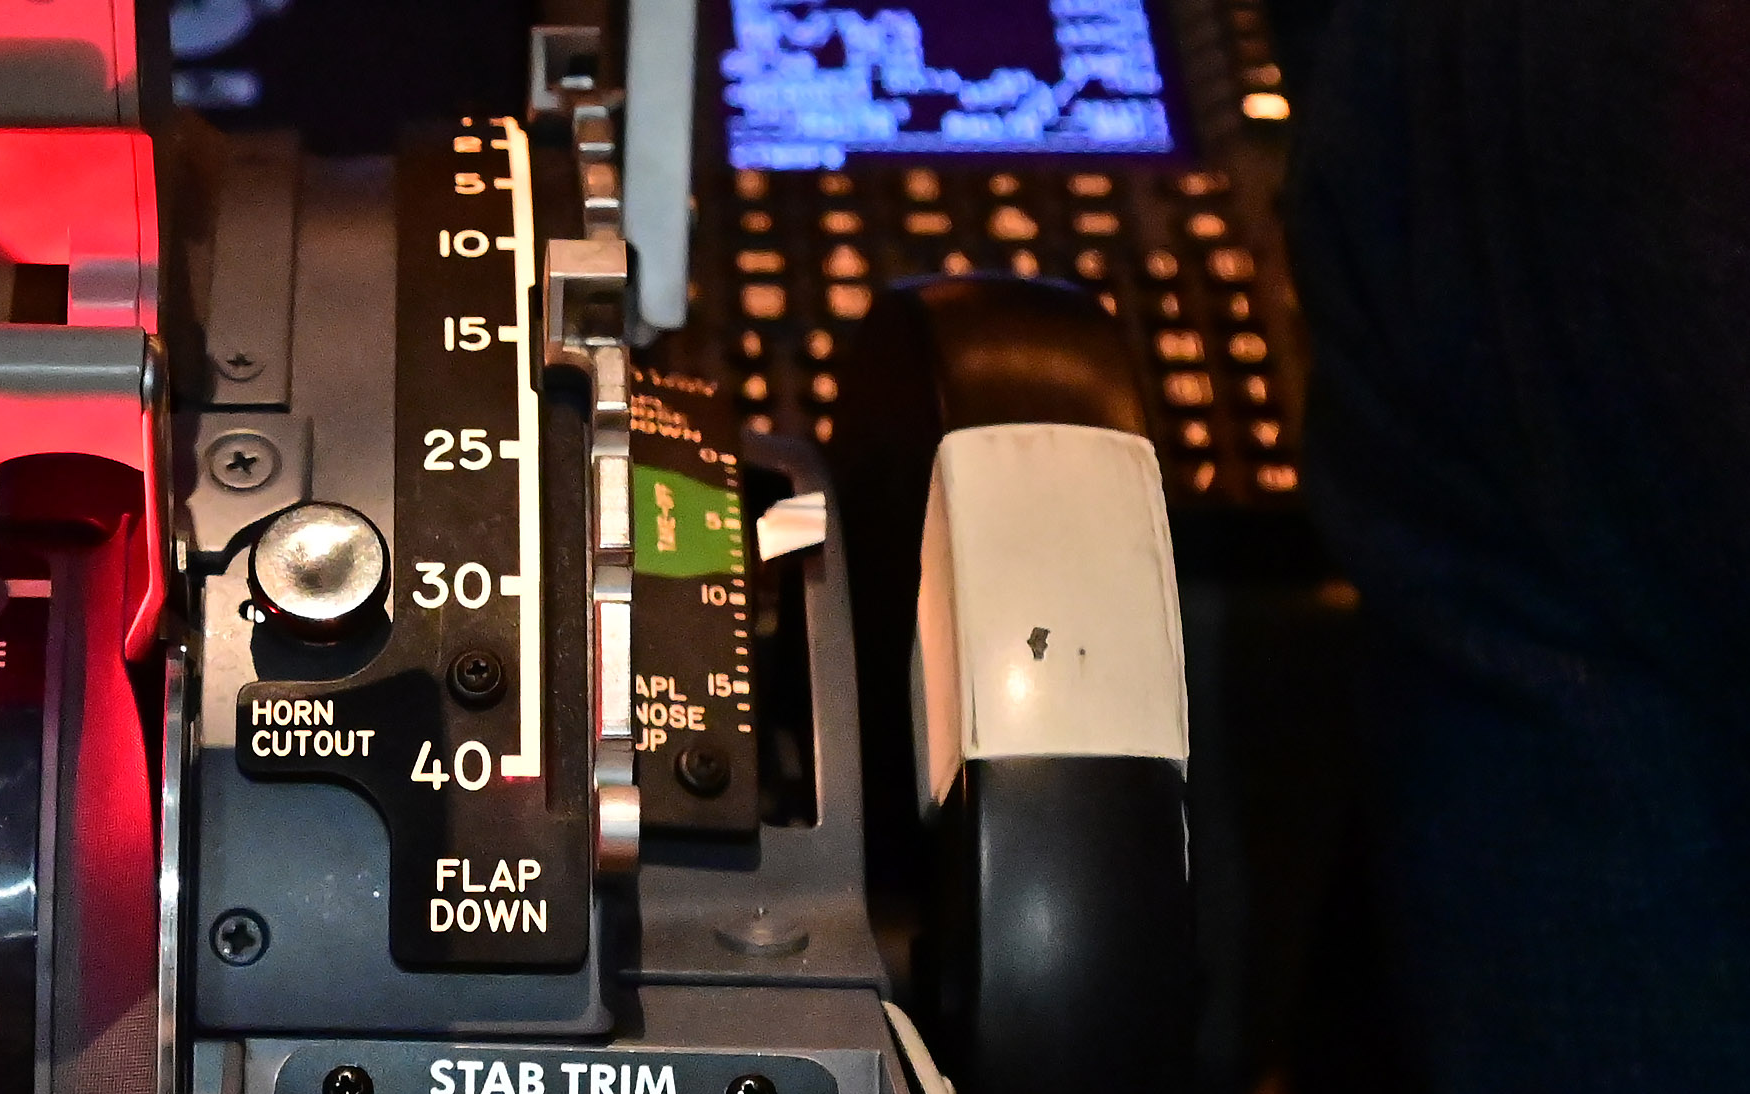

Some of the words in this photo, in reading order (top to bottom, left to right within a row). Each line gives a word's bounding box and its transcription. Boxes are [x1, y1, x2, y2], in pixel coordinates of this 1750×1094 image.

[455, 173, 486, 194] 5
[439, 230, 490, 258] 10
[444, 316, 491, 351] 15
[423, 429, 493, 471] 25
[412, 562, 492, 609] 30
[701, 584, 727, 606] 10
[707, 672, 733, 698] 15
[251, 699, 334, 725] HORN
[251, 730, 375, 757] CUTOUT
[410, 740, 492, 792] 40
[436, 859, 542, 893] FLAP
[429, 899, 548, 933] DOWN
